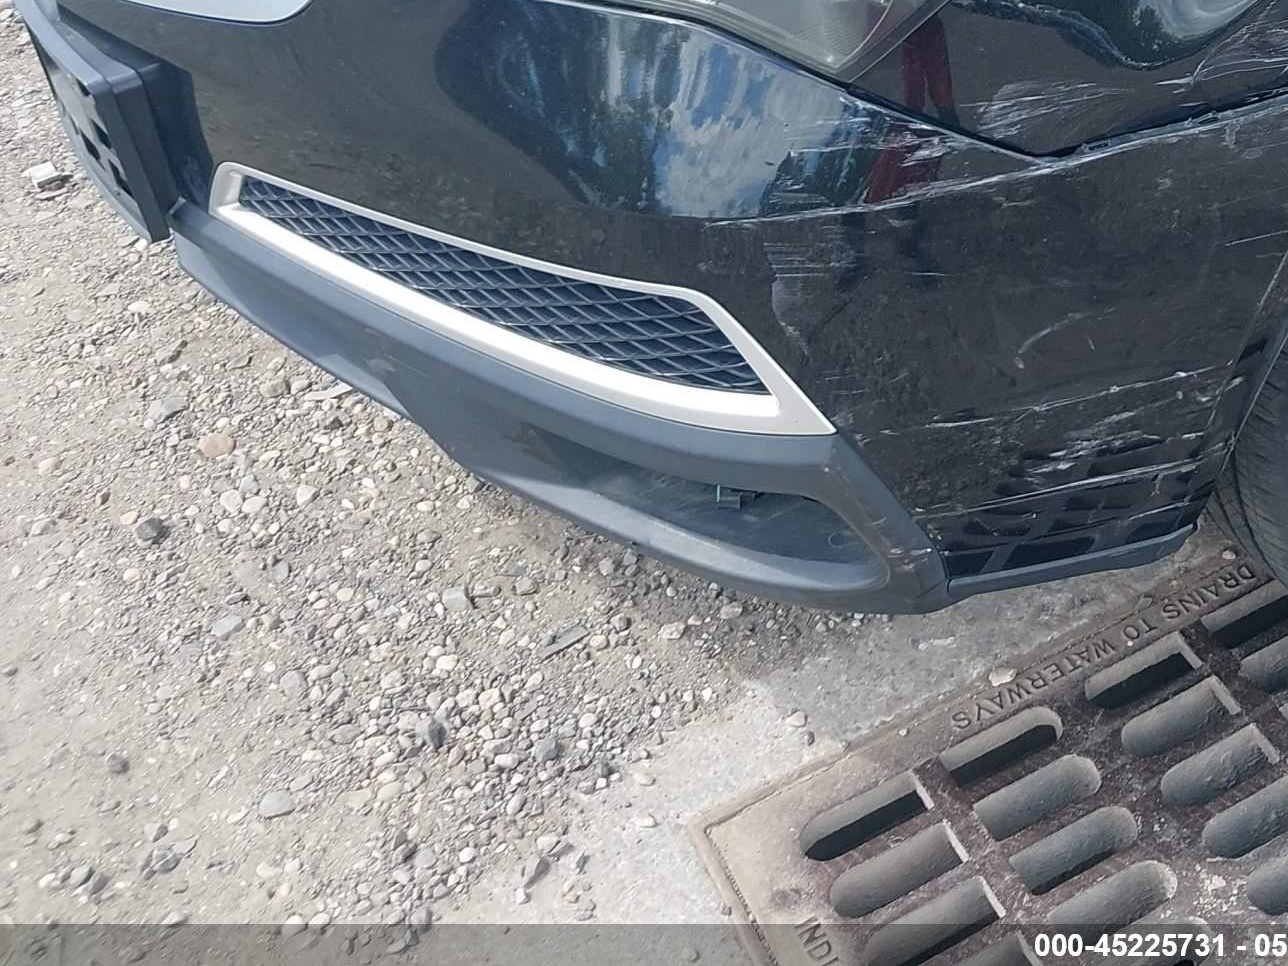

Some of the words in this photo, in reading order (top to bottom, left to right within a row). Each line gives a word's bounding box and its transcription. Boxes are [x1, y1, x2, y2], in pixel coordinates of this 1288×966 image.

[1163, 563, 1258, 621] DRAINS
[1123, 619, 1158, 645] TO
[950, 636, 1117, 731] WATERWAYS
